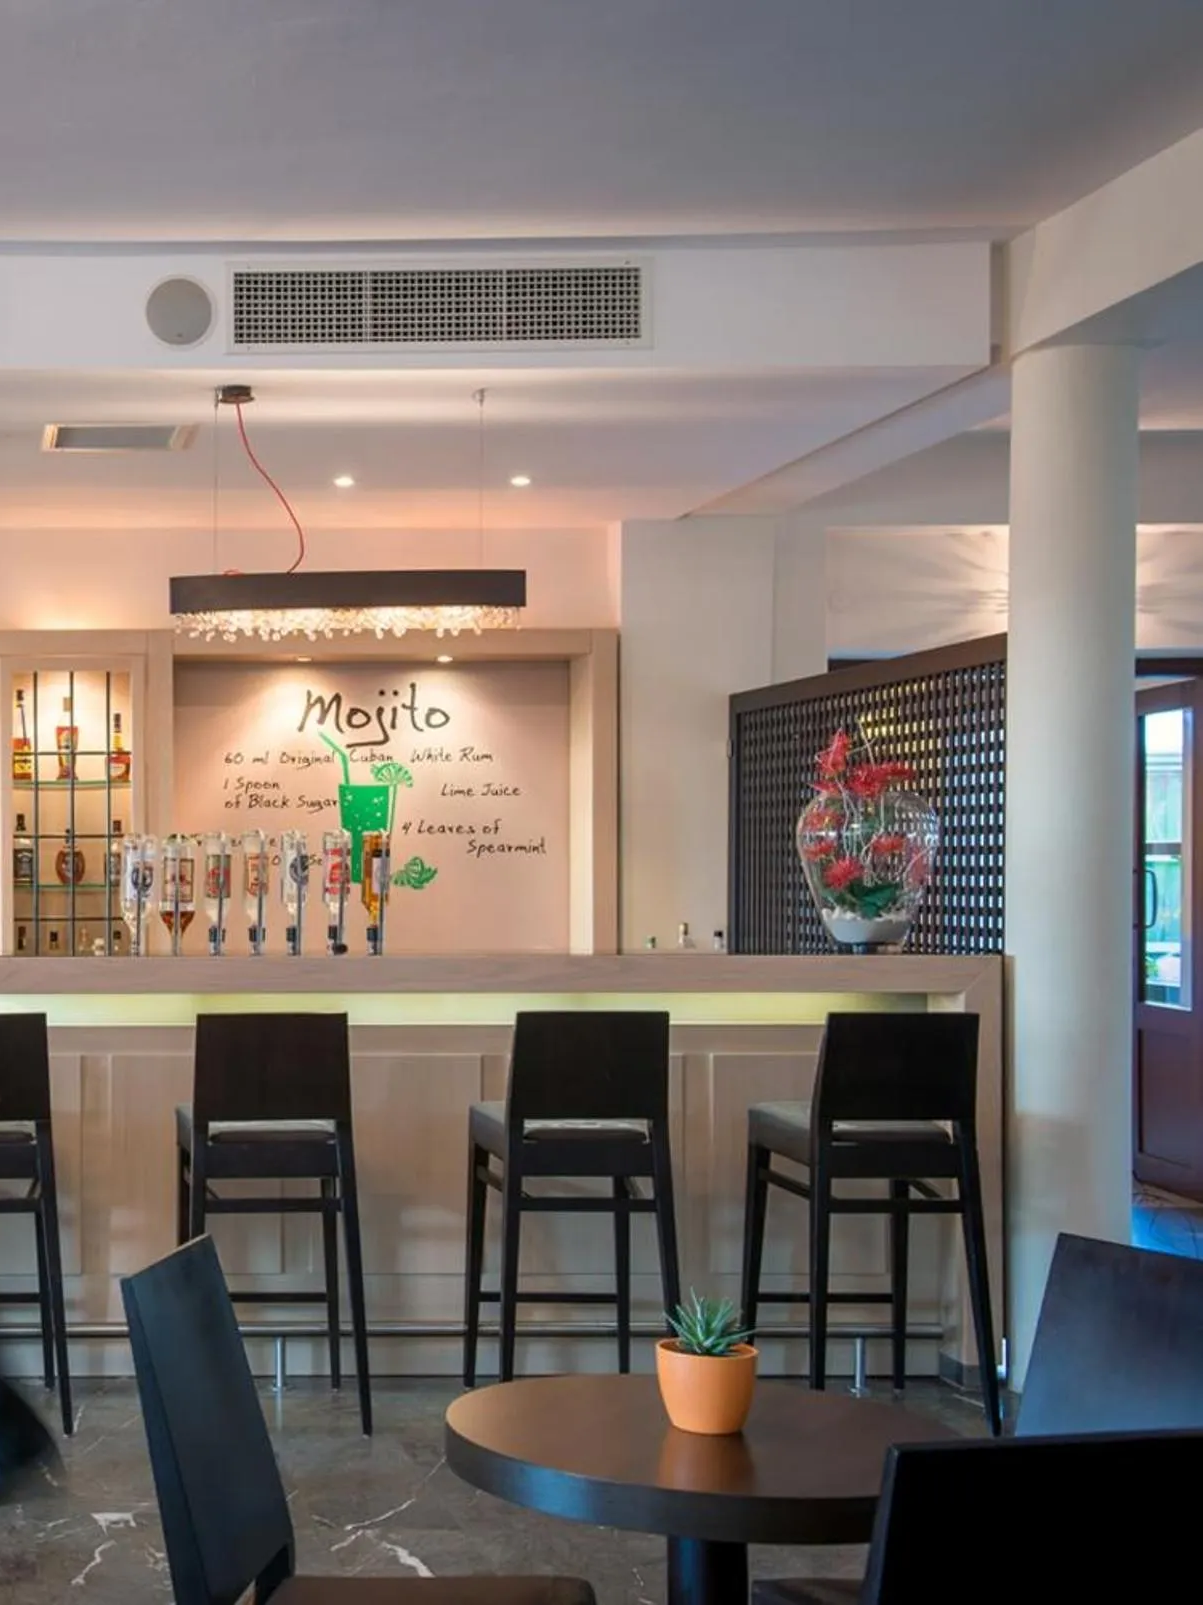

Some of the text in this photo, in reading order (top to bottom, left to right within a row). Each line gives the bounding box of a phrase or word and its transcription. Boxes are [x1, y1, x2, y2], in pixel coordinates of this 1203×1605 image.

[298, 682, 450, 748] Mojito
[224, 747, 494, 770] 60 ml Original Cuban White Rum
[235, 777, 280, 794] Spoon
[441, 783, 521, 797] Lime Juice
[224, 794, 338, 814] of Black Sugar
[402, 819, 502, 835] 4 Leaves of
[466, 837, 547, 858] Spearmint
